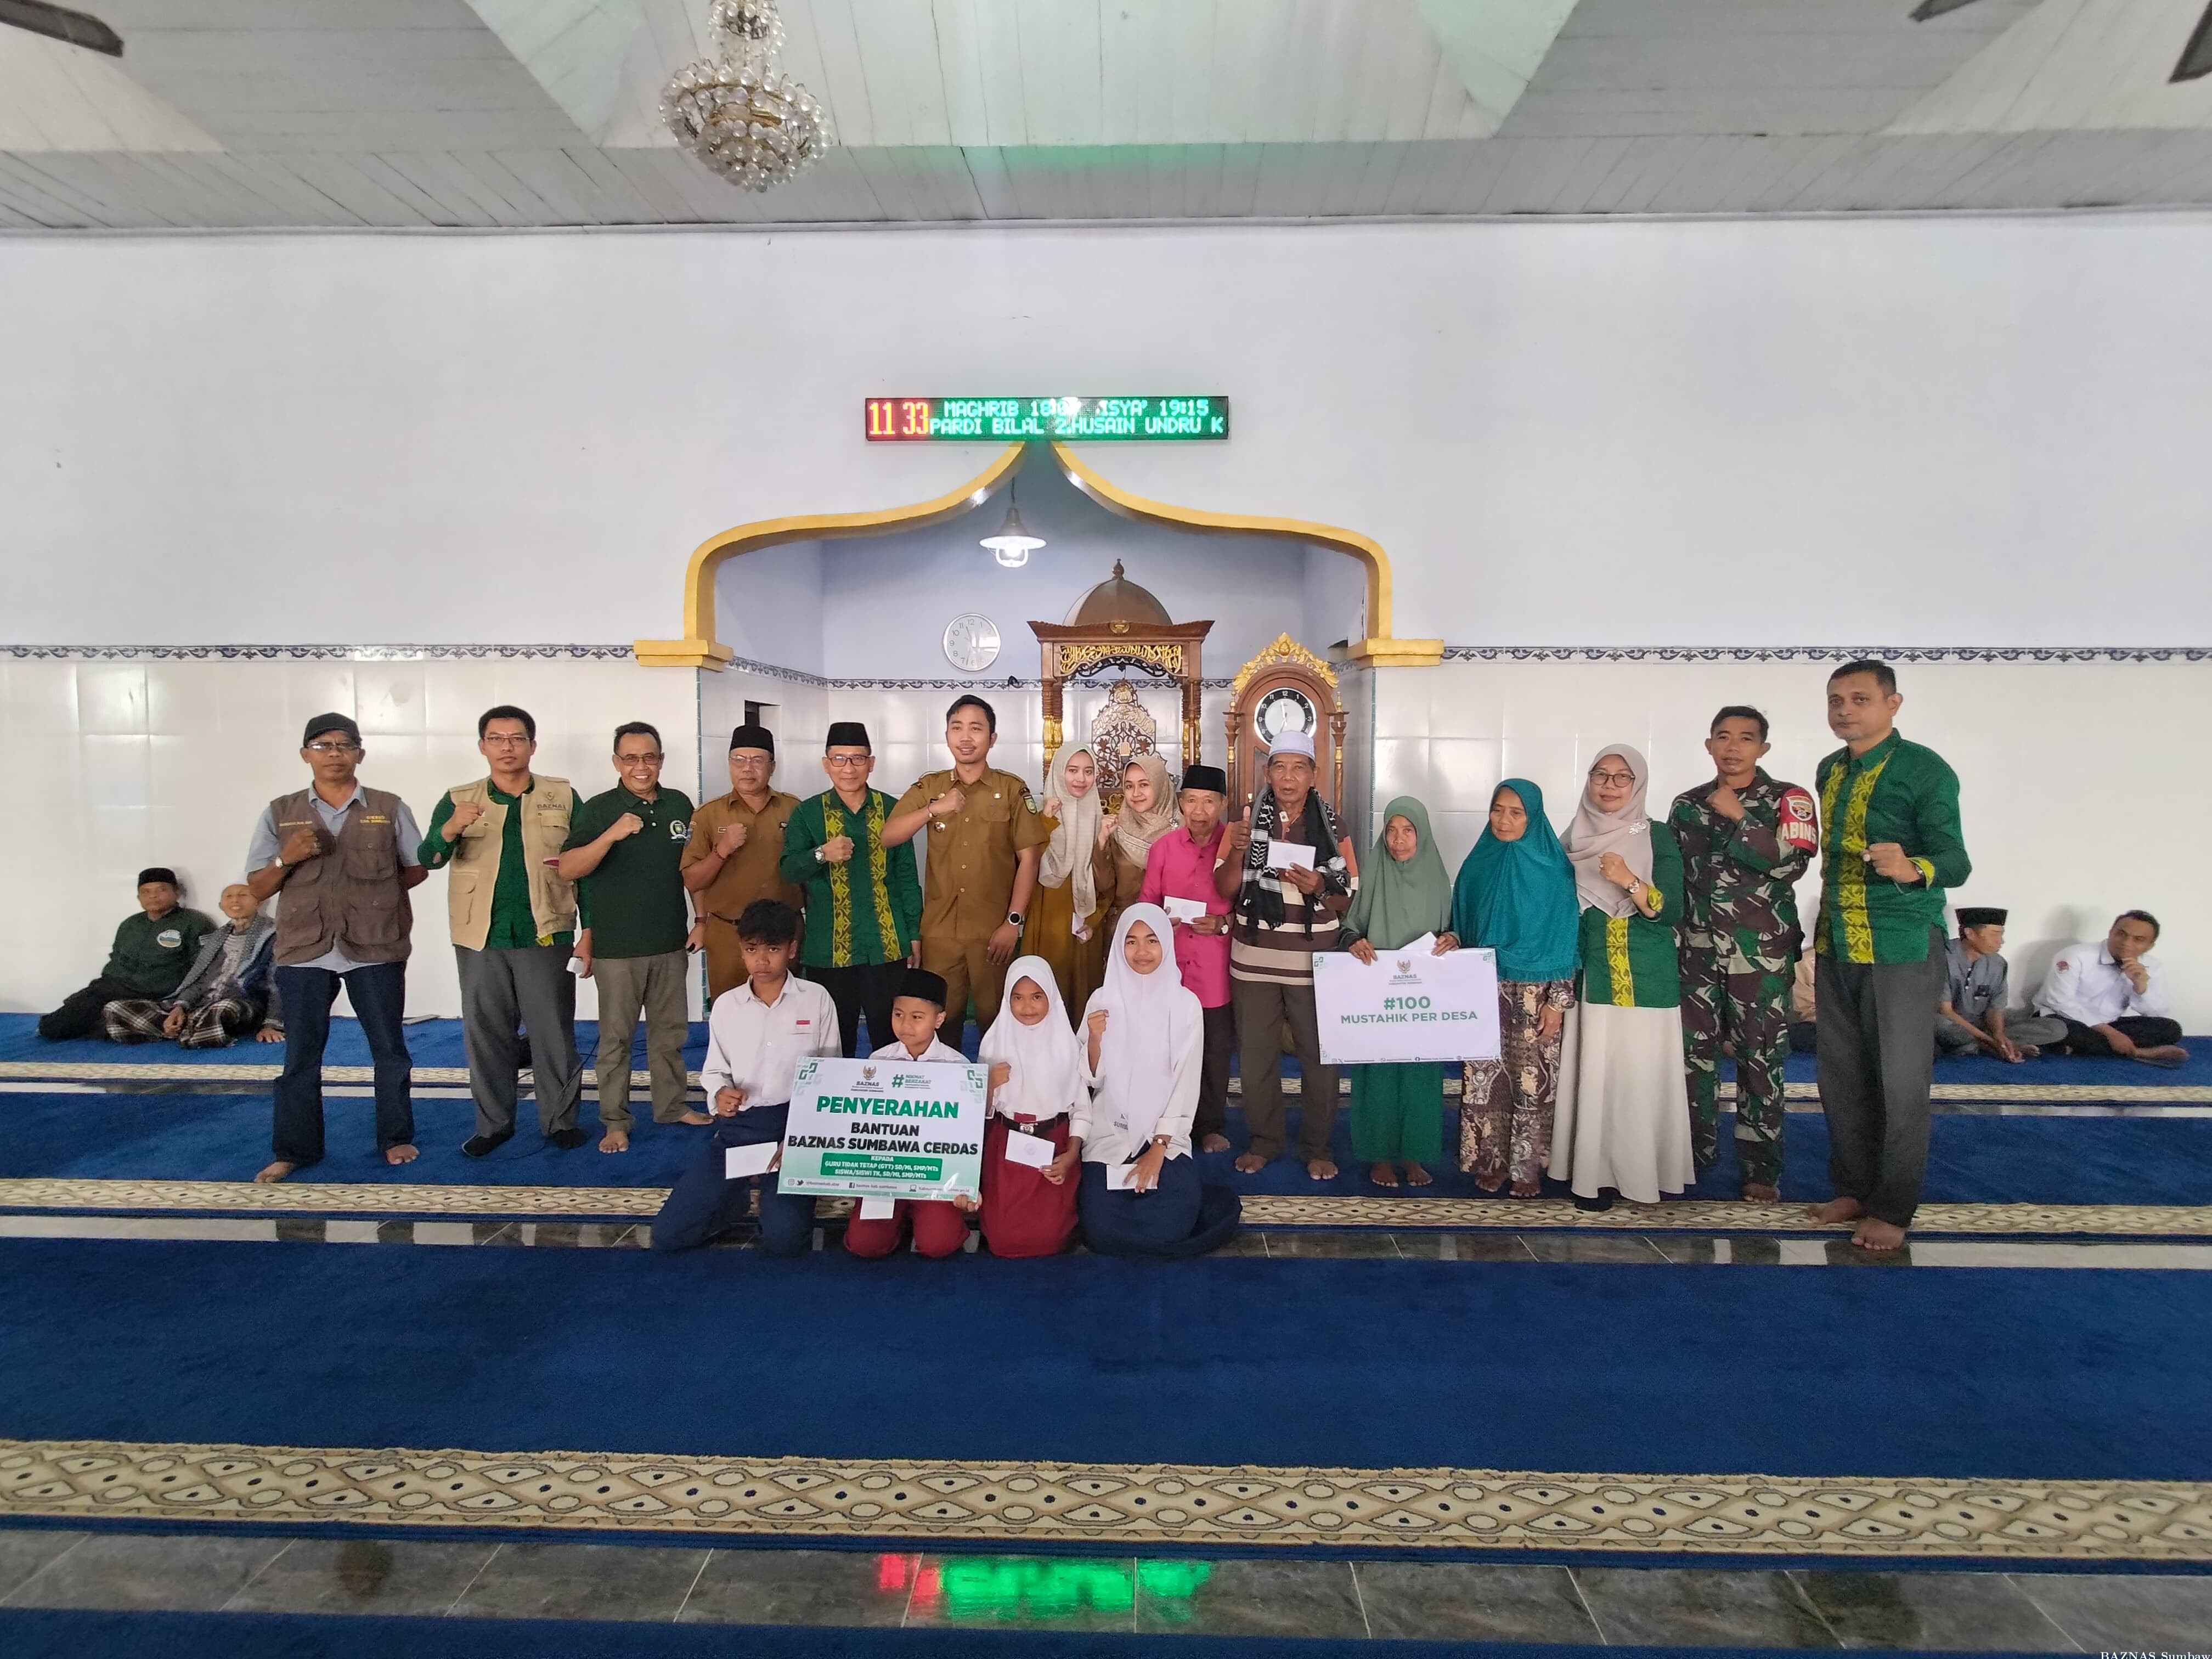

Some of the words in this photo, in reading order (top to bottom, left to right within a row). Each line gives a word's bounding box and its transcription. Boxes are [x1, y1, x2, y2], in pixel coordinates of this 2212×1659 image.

[944, 400, 1019, 417] MAGHRIB
[1160, 399, 1209, 416] 19:15
[870, 402, 895, 435] 11
[902, 402, 929, 435] 33
[930, 418, 982, 434] PARDI
[992, 417, 1045, 434] BILAL
[1145, 417, 1201, 433] UNDRU
[1211, 416, 1223, 433] K
[1384, 996, 1431, 1010] #100
[1341, 1013, 1408, 1024] MUSTAHIK
[1412, 1012, 1437, 1022] PER
[1442, 1011, 1477, 1020] DESA
[816, 1096, 958, 1118] PENYERAHAN
[851, 1122, 919, 1136] BANTUAN
[788, 1135, 845, 1149] BAZNAS
[848, 1138, 919, 1153] SUMBAWA
[923, 1141, 978, 1155] CERDAS
